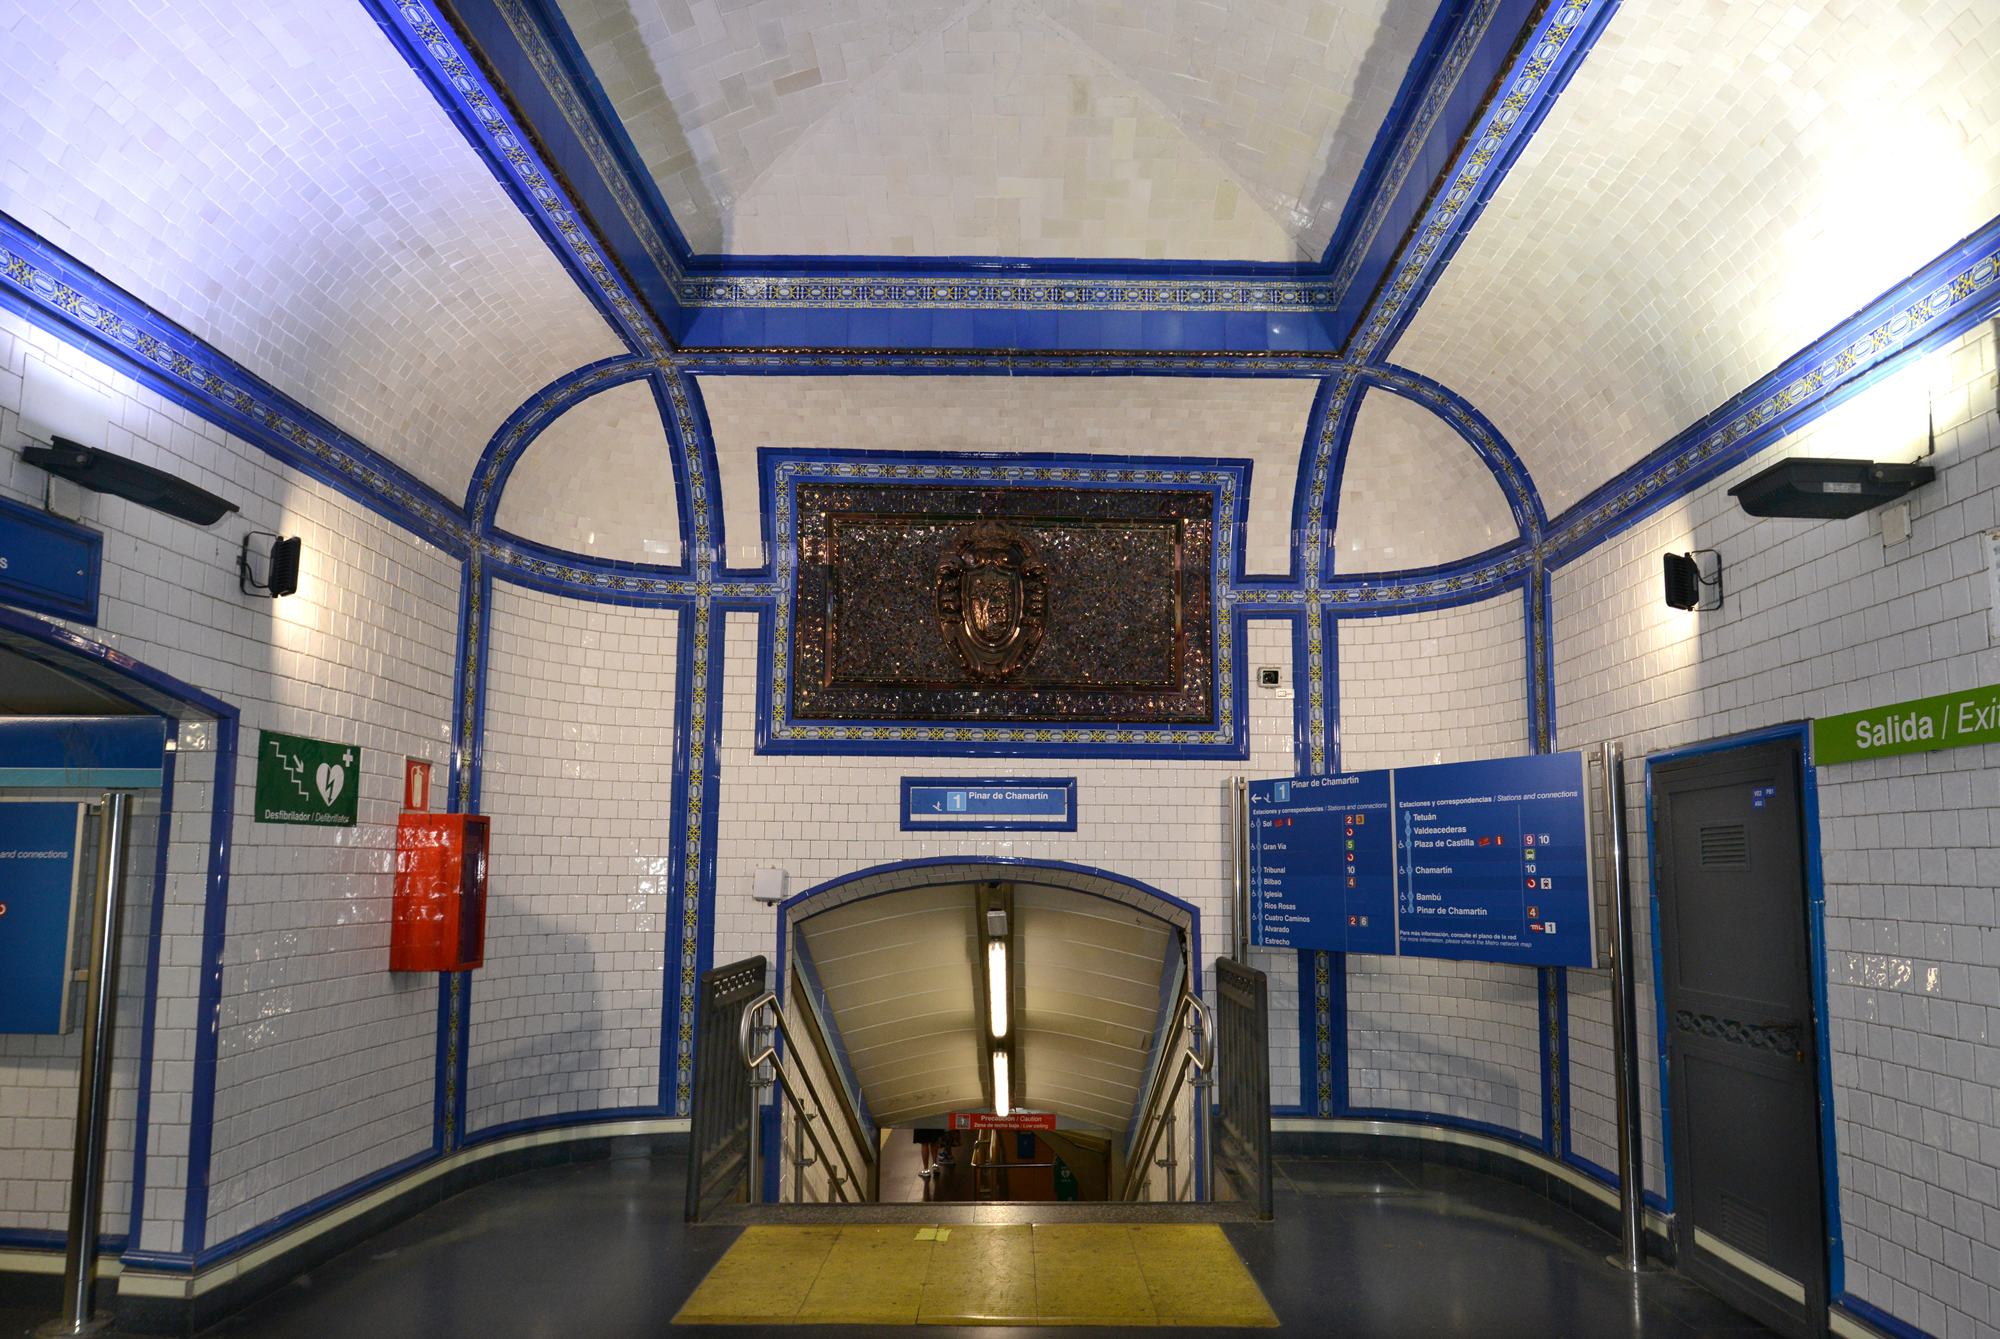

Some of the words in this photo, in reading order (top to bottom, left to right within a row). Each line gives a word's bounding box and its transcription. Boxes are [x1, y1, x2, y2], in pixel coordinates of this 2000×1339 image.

[1856, 712, 1934, 749] Salida
[1291, 779, 1309, 788] Pinar
[1311, 778, 1320, 787] de
[1321, 775, 1359, 786] Chamartín
[969, 792, 990, 800] Pinar
[992, 791, 1003, 800] de
[1005, 791, 1049, 800] Chamartín
[1399, 801, 1431, 809] Estaciones
[1437, 796, 1492, 807] correspondencias
[1497, 794, 1522, 802] Stations
[1537, 790, 1578, 800] connections
[953, 794, 960, 809] 1
[1253, 808, 1278, 816] Estaciones
[1282, 805, 1324, 814] correspondencias
[1327, 804, 1346, 812] Stations
[1356, 802, 1388, 810] connections
[264, 809, 310, 820] Desfibrilador
[1413, 813, 1437, 821] Tetuán
[1263, 820, 1273, 828] Sol
[1413, 826, 1467, 835] Valdeacederas
[1414, 840, 1434, 848] Plaza
[1435, 839, 1445, 847] de
[1446, 839, 1475, 847] Castilla
[1539, 835, 1550, 844] 10
[1347, 841, 1353, 849] 5
[17, 851, 68, 859] connections
[1264, 866, 1286, 874] Tribunal
[1347, 865, 1356, 874] 10
[1415, 866, 1453, 875] Chamartín
[1526, 864, 1537, 874] 10
[1264, 890, 1283, 899] Iglesia
[1416, 893, 1442, 901] Bambú
[1278, 903, 1296, 911] Rosas
[1416, 907, 1436, 915] Pinar
[1436, 907, 1447, 915] de
[1448, 907, 1488, 916] Chamartín
[1529, 908, 1536, 917] 4
[1264, 914, 1284, 922] Cuatro
[1284, 915, 1311, 923] Caminos
[1361, 917, 1367, 926] 6
[1265, 937, 1290, 945] Estrecho
